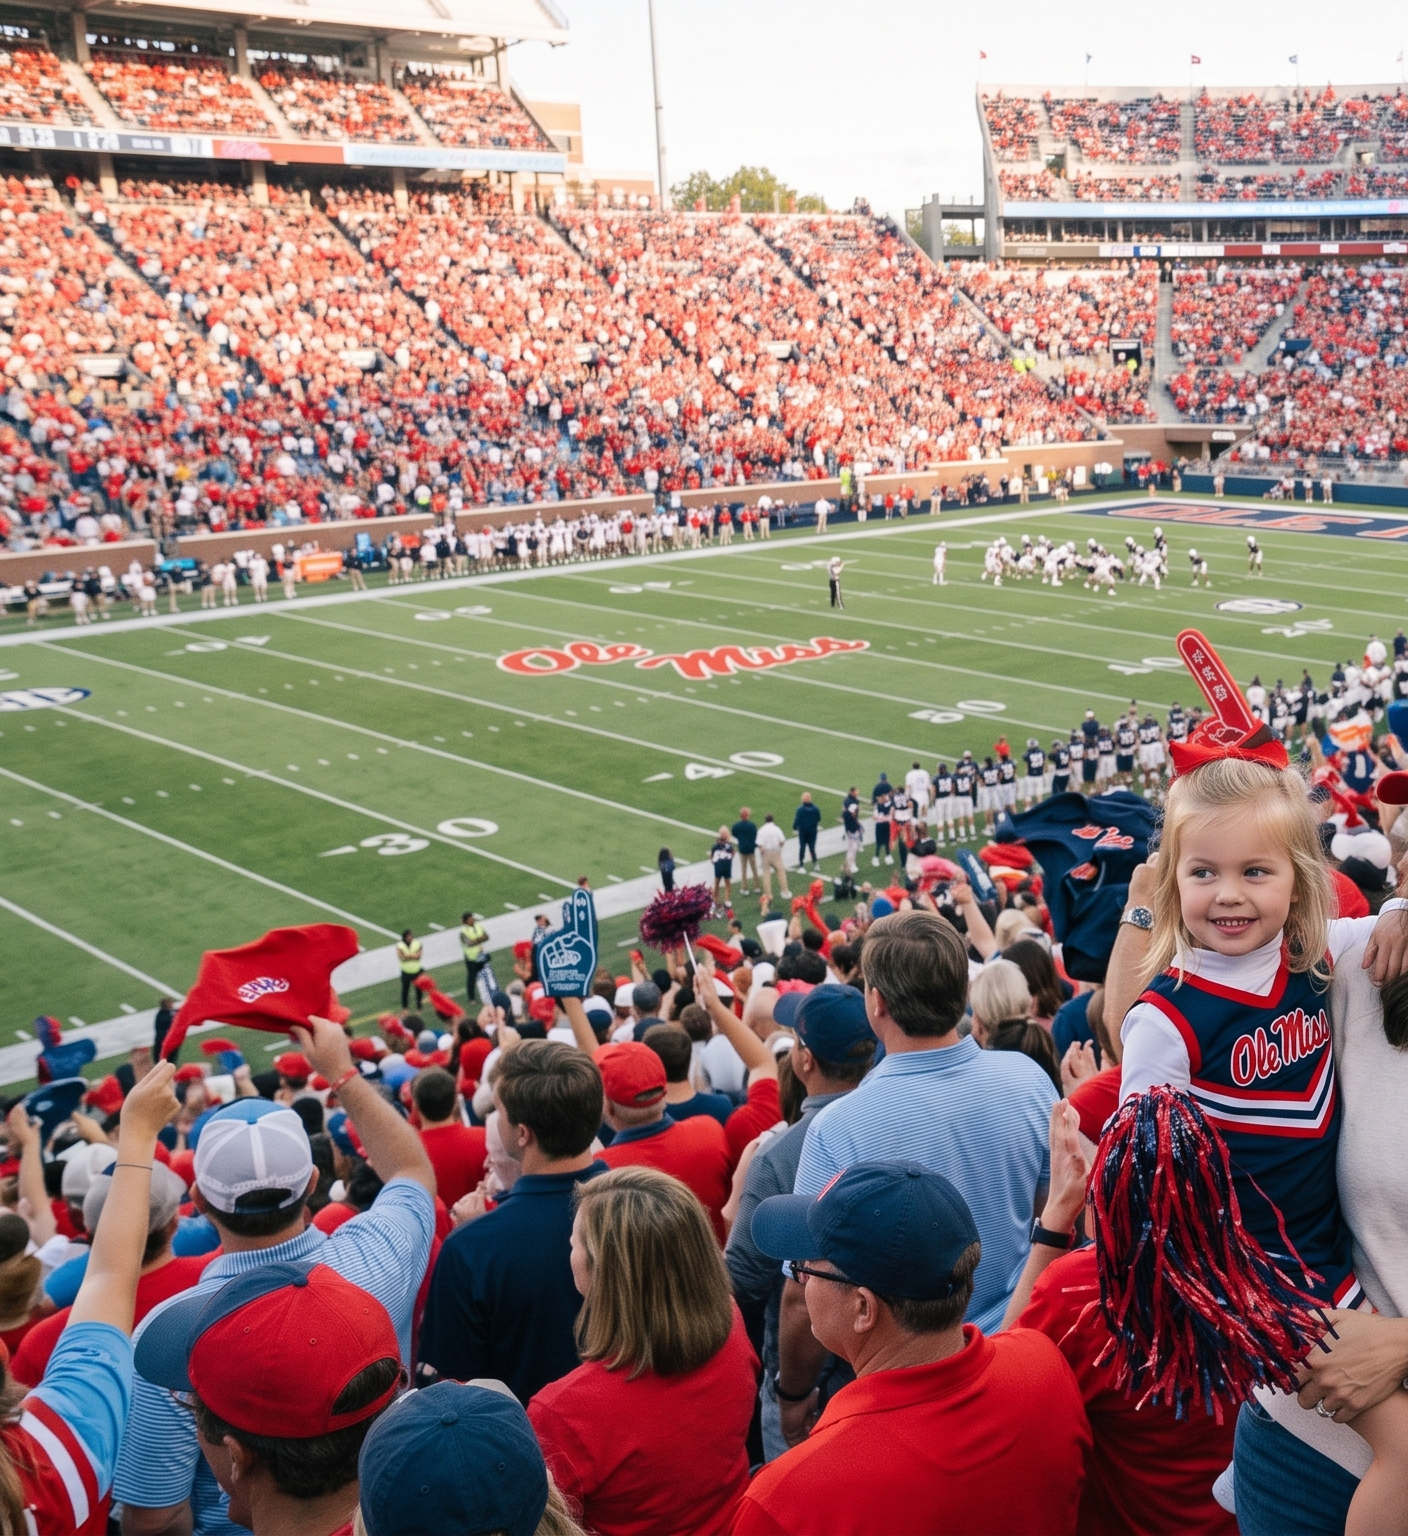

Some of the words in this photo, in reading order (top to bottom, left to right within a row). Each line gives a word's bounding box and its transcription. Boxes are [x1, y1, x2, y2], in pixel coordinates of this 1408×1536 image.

[496, 640, 654, 677] Ole
[635, 636, 871, 681] Miss
[685, 750, 785, 780] 40
[359, 817, 499, 856] 30
[1231, 1026, 1282, 1087] Ole
[1270, 1007, 1332, 1066] Miss
